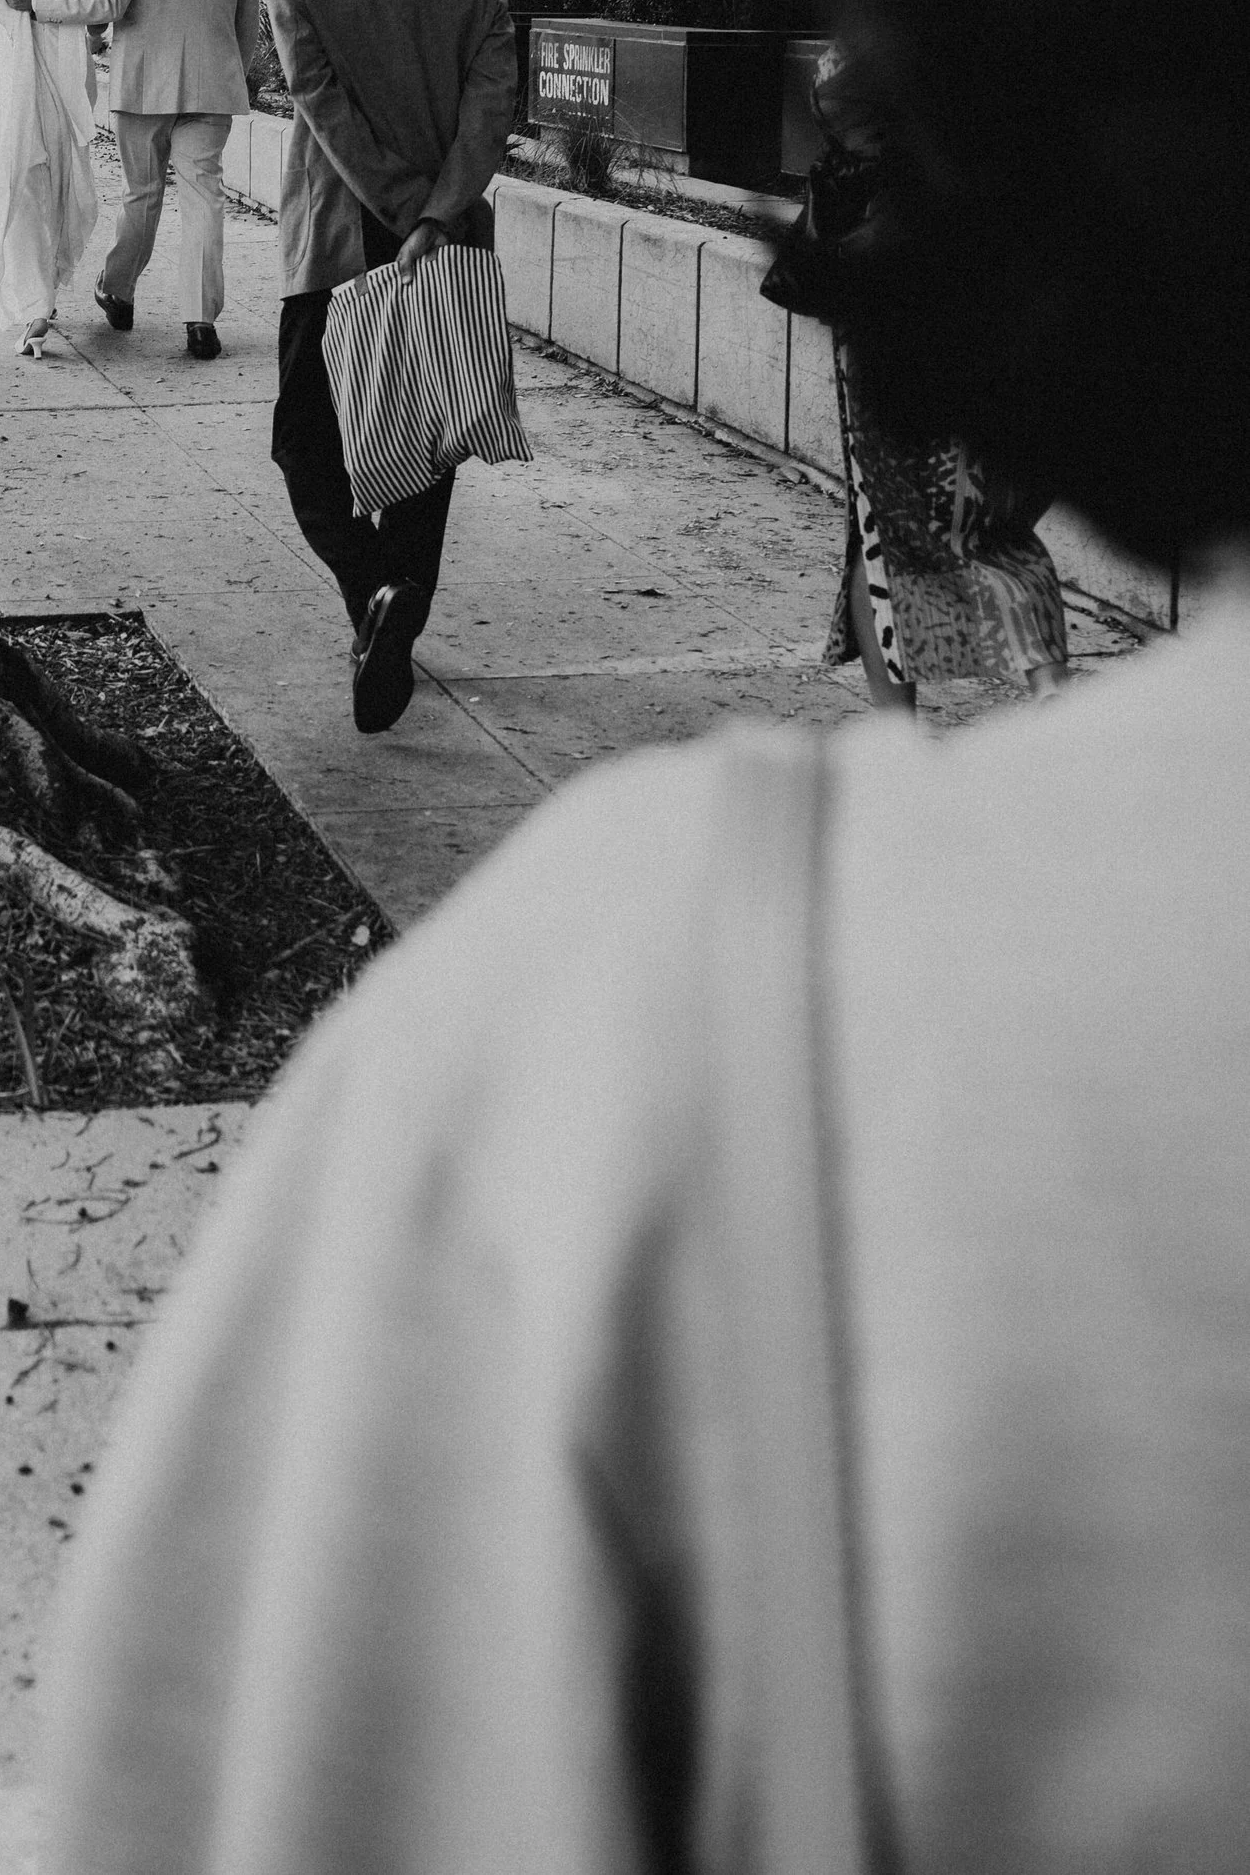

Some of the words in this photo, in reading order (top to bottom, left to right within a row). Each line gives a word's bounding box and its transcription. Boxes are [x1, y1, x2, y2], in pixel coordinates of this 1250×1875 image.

[540, 41, 559, 69] FIRE
[562, 43, 611, 75] SPRINKLER
[539, 71, 609, 106] CONNECTION
